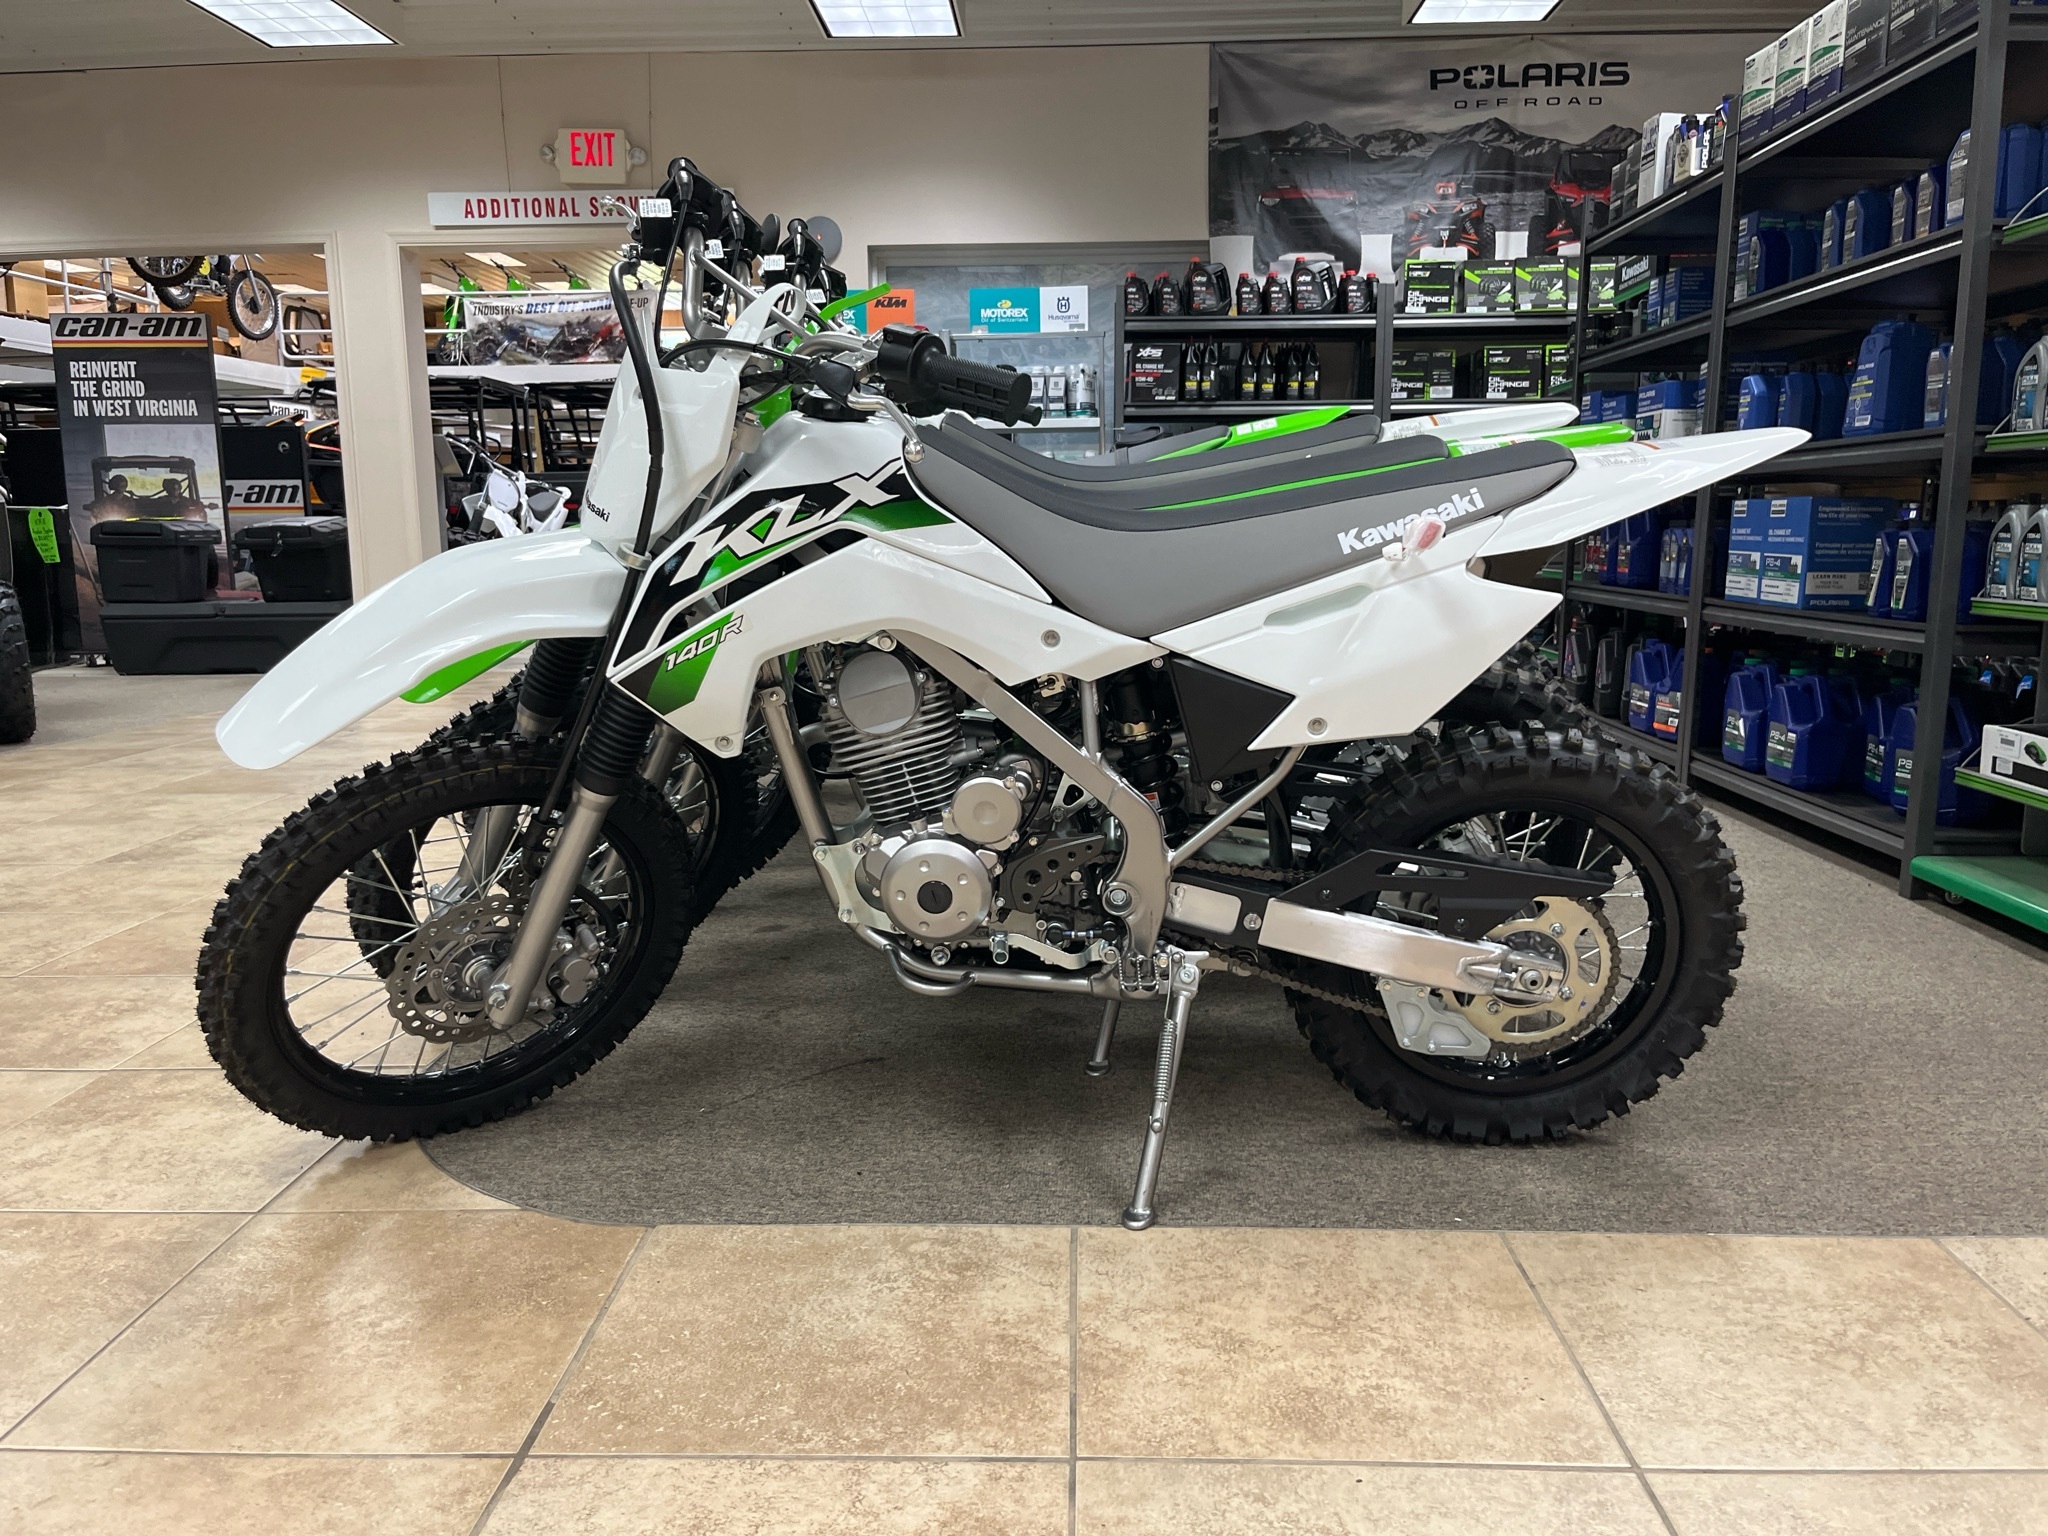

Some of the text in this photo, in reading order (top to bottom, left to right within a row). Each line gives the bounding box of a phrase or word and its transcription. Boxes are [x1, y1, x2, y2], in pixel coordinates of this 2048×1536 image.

[1430, 62, 1630, 90] POLARIS
[1454, 97, 1611, 109] OFF ROAD
[569, 131, 616, 166] EXIT
[464, 197, 580, 218] ADDITIONAL
[473, 304, 524, 316] INDUSTRY'S
[525, 302, 556, 315] BEST
[874, 297, 907, 308] KTM
[981, 308, 1029, 318] MOTOREX
[55, 317, 203, 337] can-am
[1136, 347, 1163, 358] XPS
[69, 361, 137, 379] REINVENT
[71, 380, 146, 398] THE GRIND
[74, 400, 199, 417] IN WEST VIRGINIA
[669, 455, 910, 587] KLX
[665, 614, 745, 672] 140R
